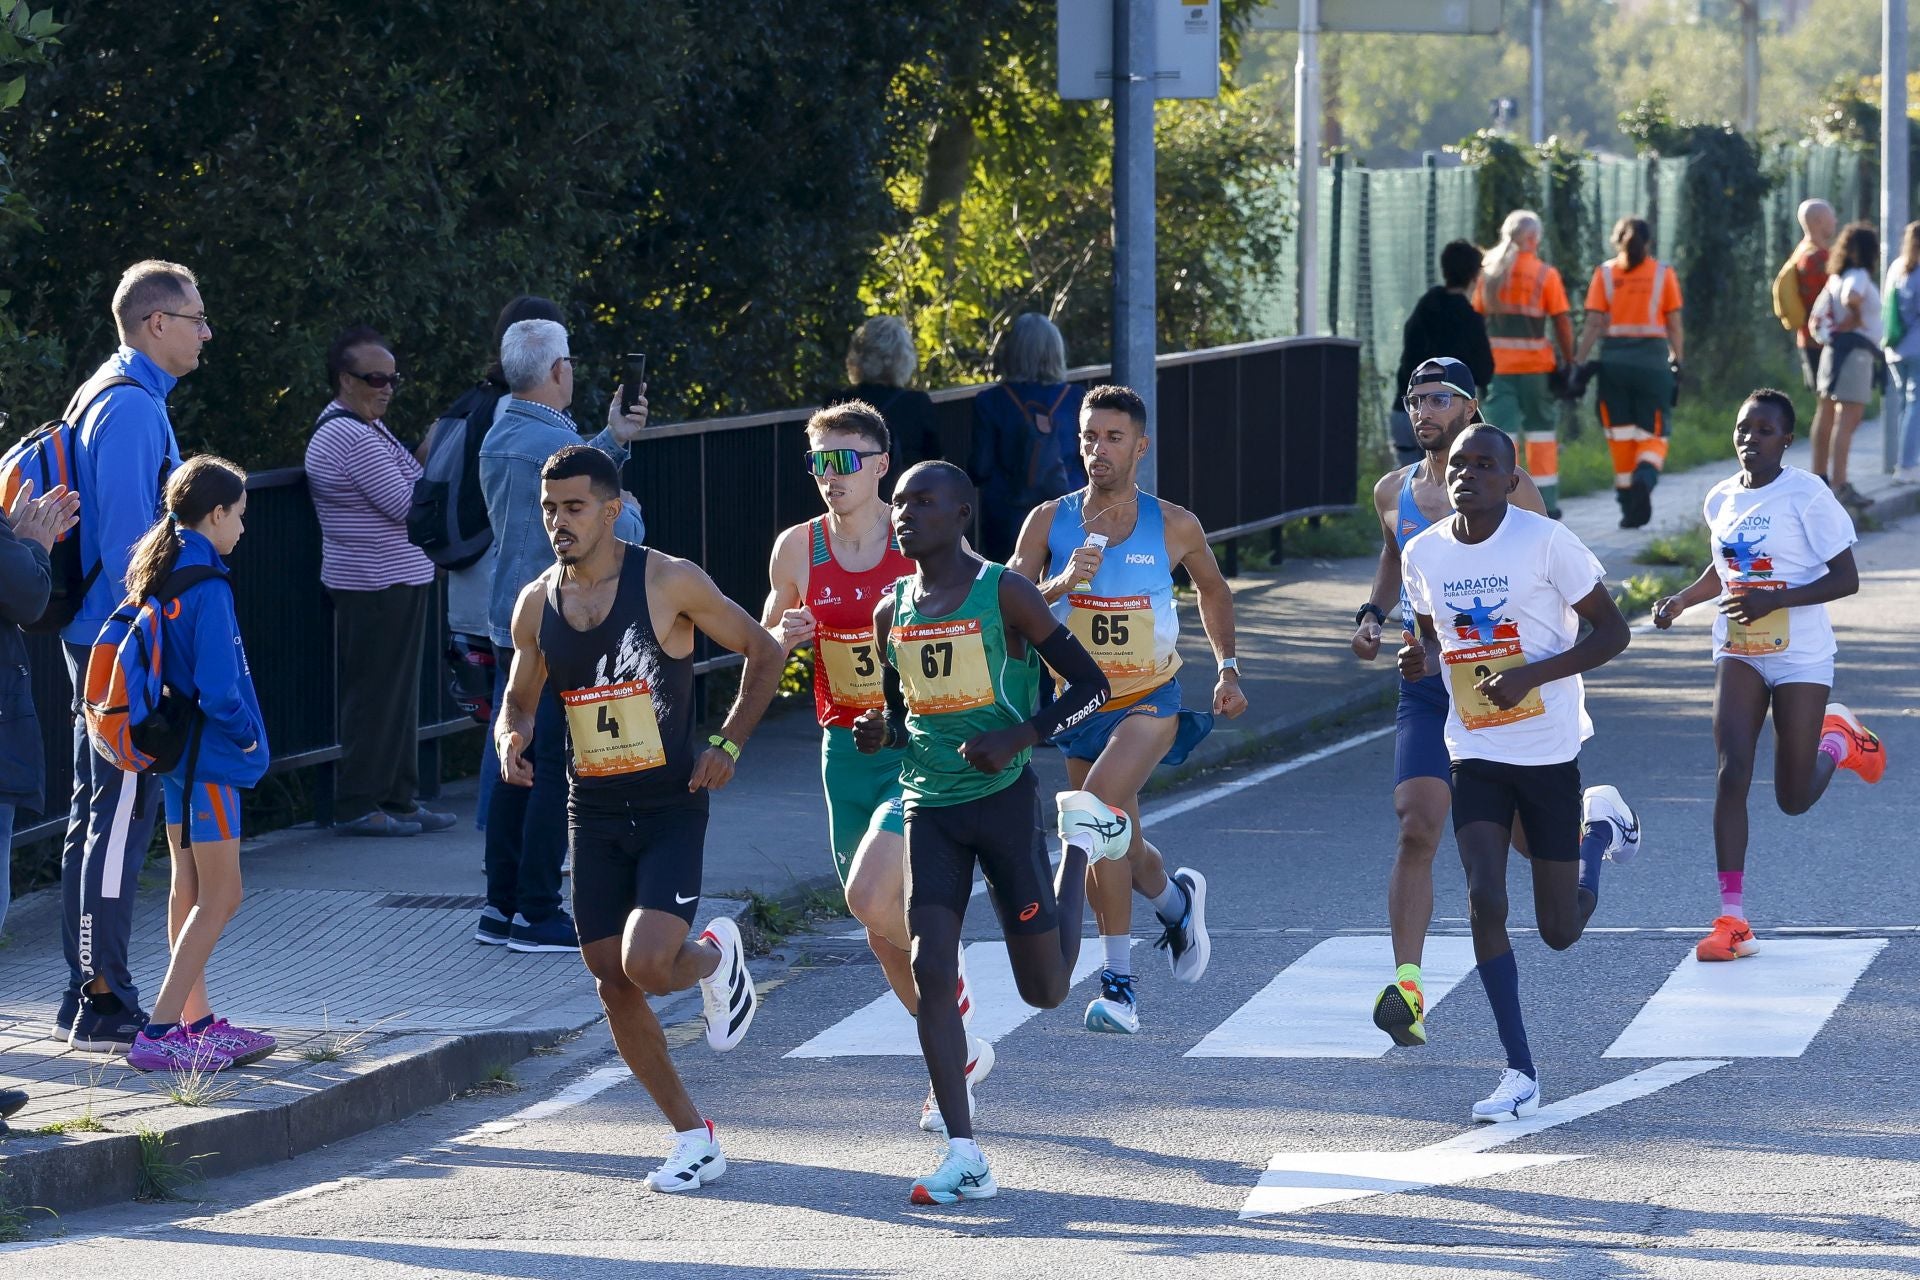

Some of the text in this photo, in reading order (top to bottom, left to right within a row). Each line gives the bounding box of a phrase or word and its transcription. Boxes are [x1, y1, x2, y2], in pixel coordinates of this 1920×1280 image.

[1125, 553, 1155, 565] HOKA
[1443, 574, 1509, 592] MARATÓN
[1460, 588, 1486, 597] LECCIÓN
[1092, 600, 1109, 608] MBA
[1123, 599, 1141, 607] GIJÓN
[945, 625, 966, 634] GIJÓN
[1092, 614, 1129, 646] 65
[1489, 648, 1507, 656] GIJÓN
[852, 645, 875, 677] 3
[920, 642, 953, 679] 67
[580, 692, 601, 702] MBA
[613, 687, 634, 696] GIJÓN
[1066, 694, 1102, 728] TERREX
[597, 705, 620, 738] 4
